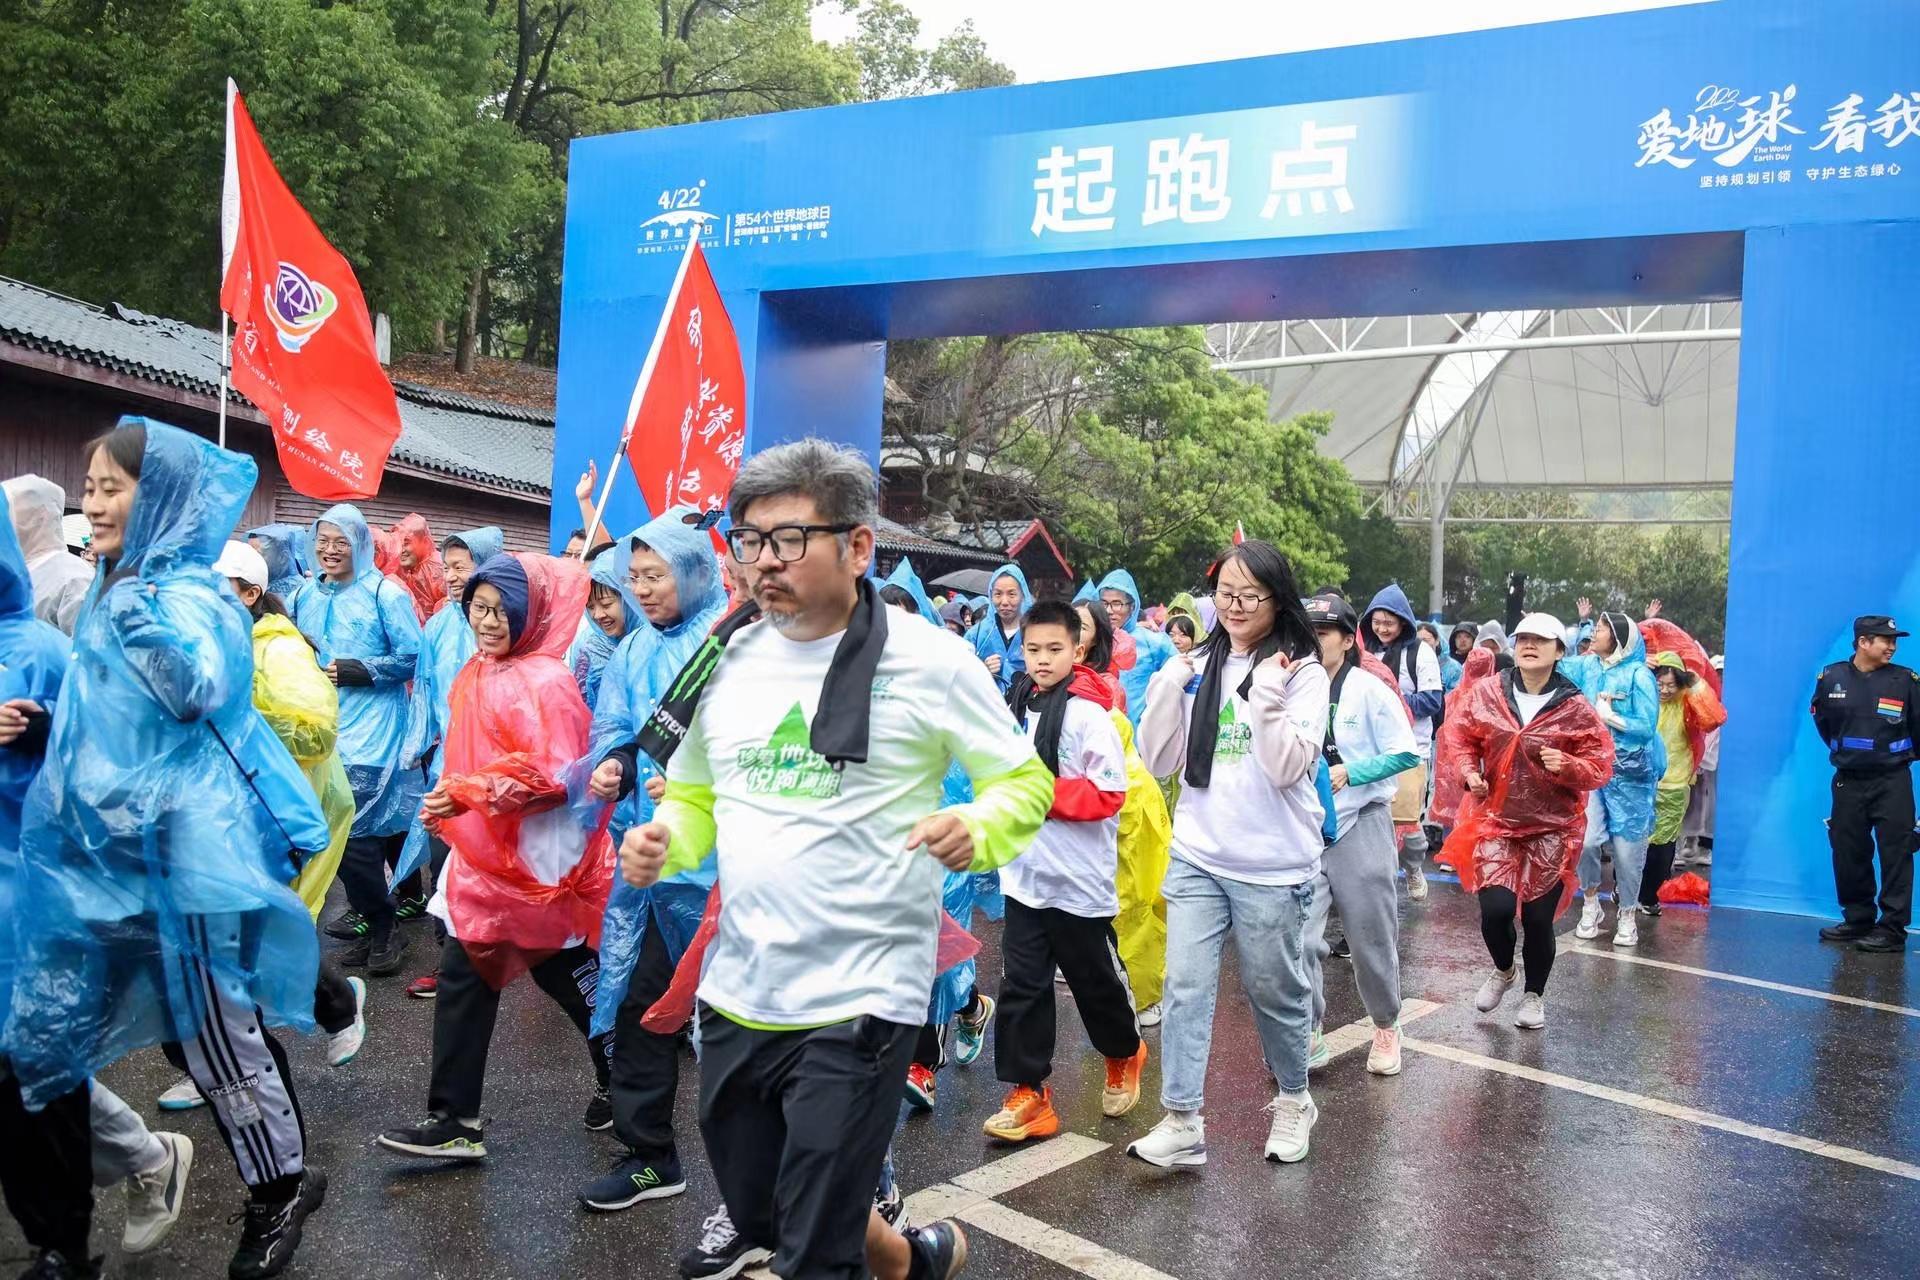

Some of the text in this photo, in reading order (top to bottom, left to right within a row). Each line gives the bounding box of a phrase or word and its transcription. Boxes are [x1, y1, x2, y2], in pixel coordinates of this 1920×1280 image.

[1634, 83, 1807, 168] 爱地球
[1753, 153, 1790, 162] Earth Day
[1769, 144, 1792, 153] World
[1030, 120, 1357, 238] 起跑点
[1699, 169, 1792, 188] 坚持规划引领
[657, 186, 701, 209] 4/22
[734, 205, 831, 227] 第54个世界地球日
[287, 444, 319, 466] HUNAN
[319, 462, 361, 489] PROVINCE
[209, 1075, 260, 1097] adidas
